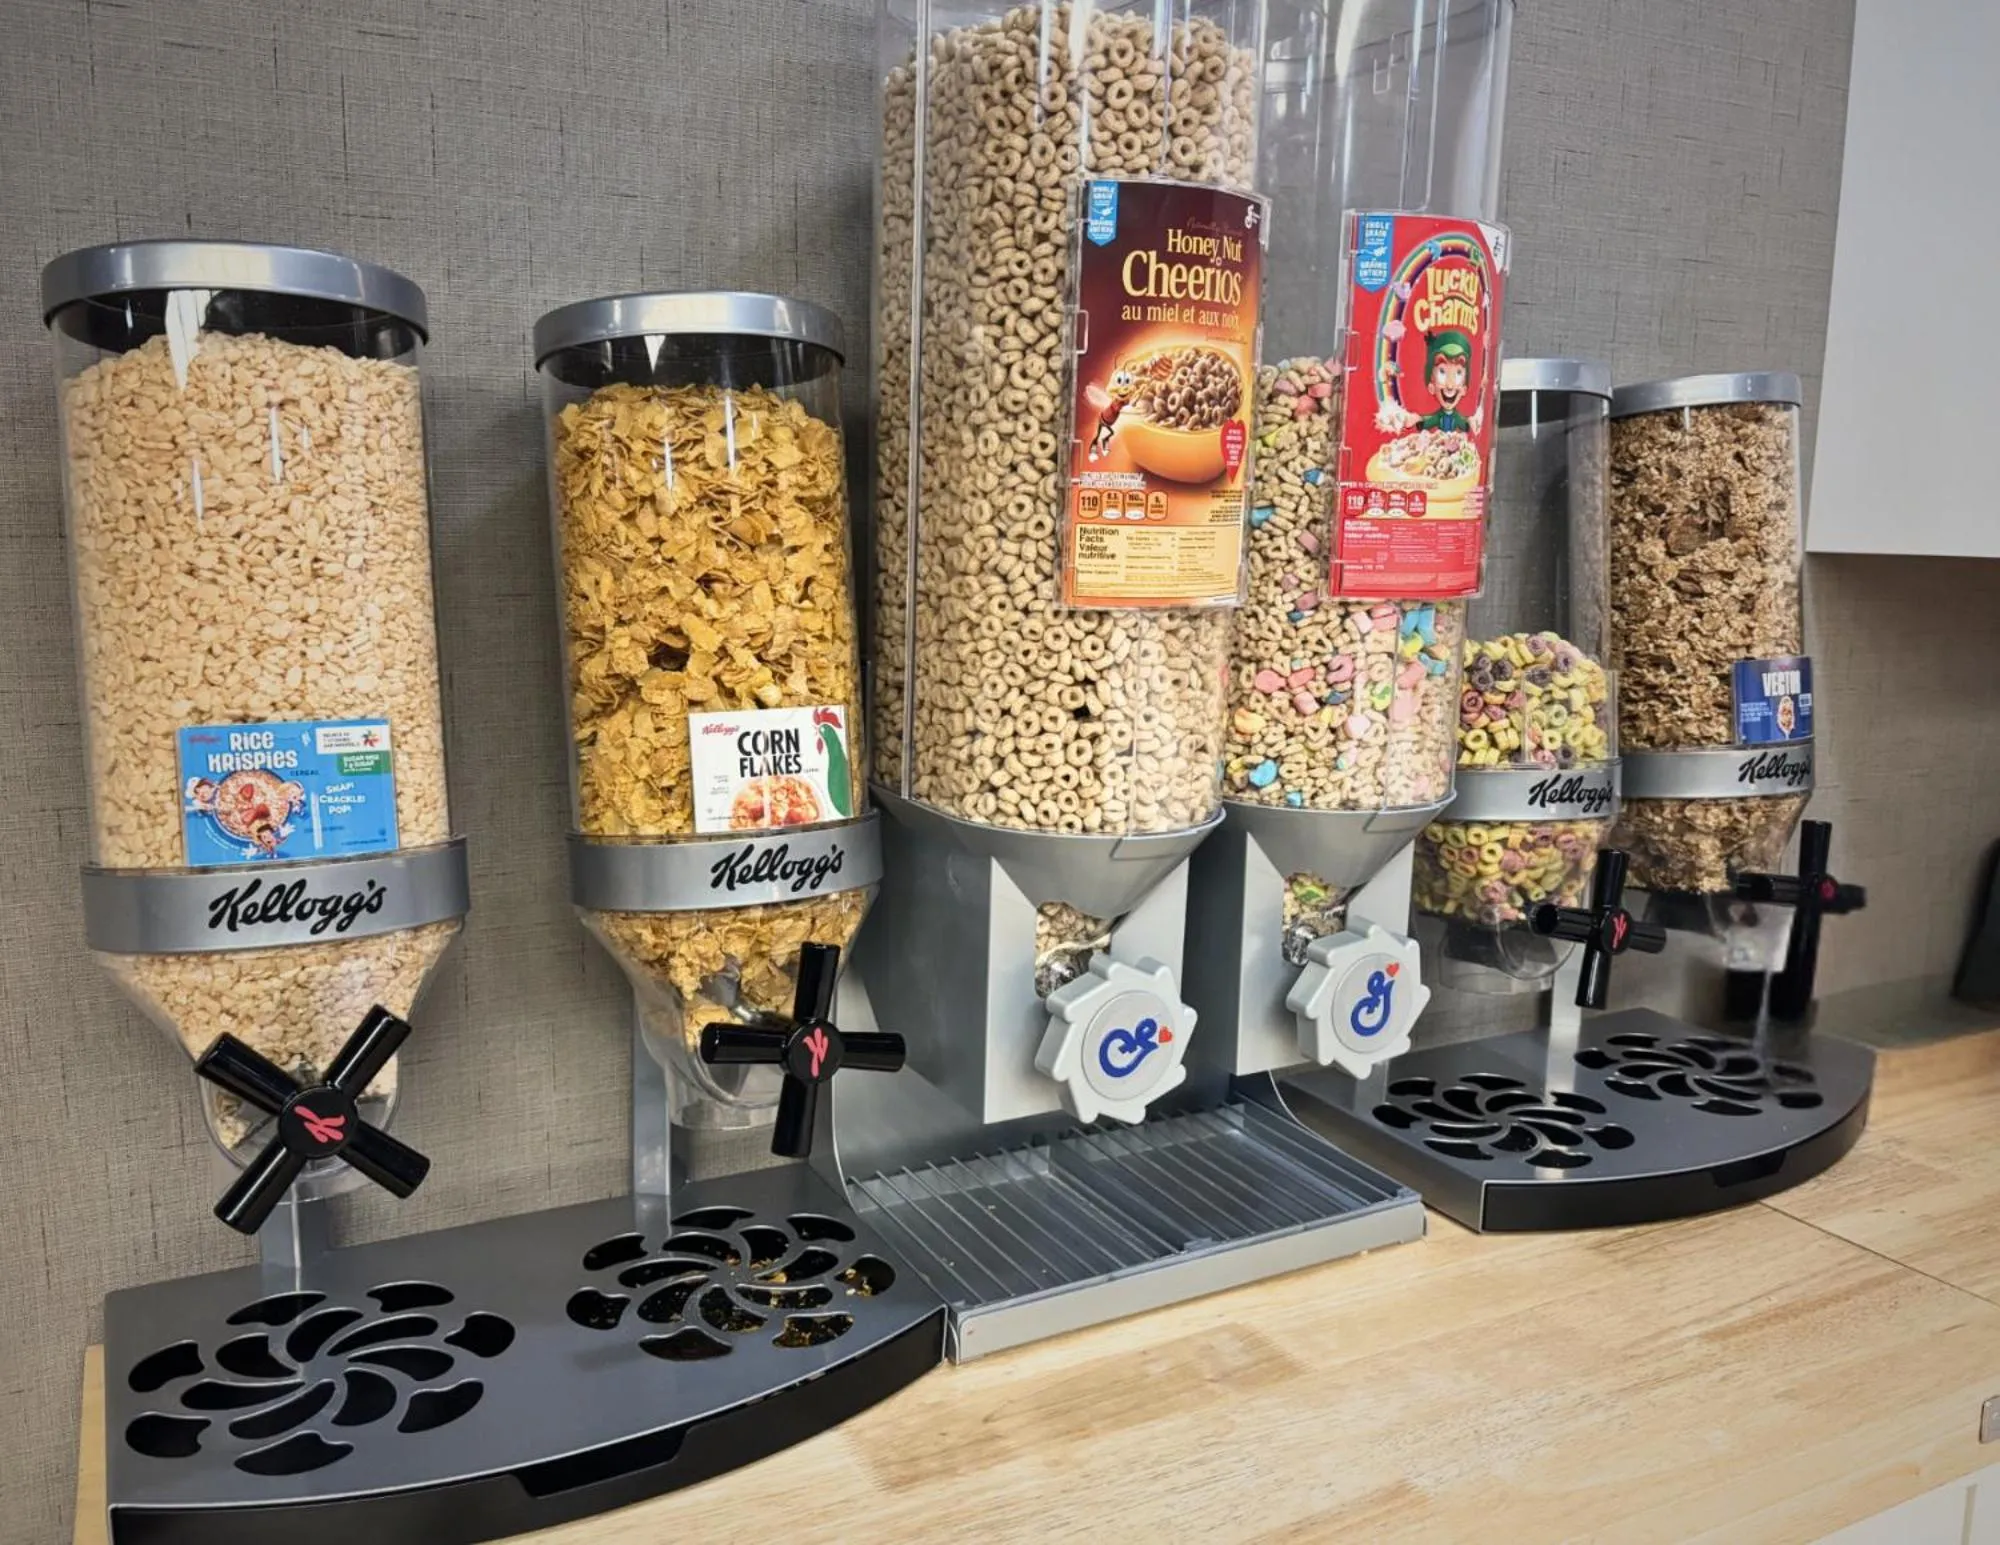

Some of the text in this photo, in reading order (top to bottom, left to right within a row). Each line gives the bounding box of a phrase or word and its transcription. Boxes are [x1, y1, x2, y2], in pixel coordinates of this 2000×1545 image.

[1168, 229, 1243, 263] Honey Nut
[1122, 250, 1241, 306] Cheerios
[1426, 267, 1479, 305] Lucky
[1121, 305, 1141, 321] au
[1147, 303, 1179, 322] miel
[1183, 305, 1196, 324] et
[1199, 309, 1220, 327] aux
[1414, 298, 1480, 336] Charms
[1081, 495, 1099, 507] 110
[1079, 527, 1120, 537] Nutrition
[1079, 535, 1104, 544] Facts
[1078, 552, 1117, 561] nutritive
[1079, 543, 1109, 552] Valeur
[737, 728, 801, 757] CORN
[739, 753, 803, 778] FLAKES
[1528, 773, 1613, 813] Kellogg's
[709, 843, 844, 892] Kellogg's
[208, 877, 387, 935] Kellogg's
